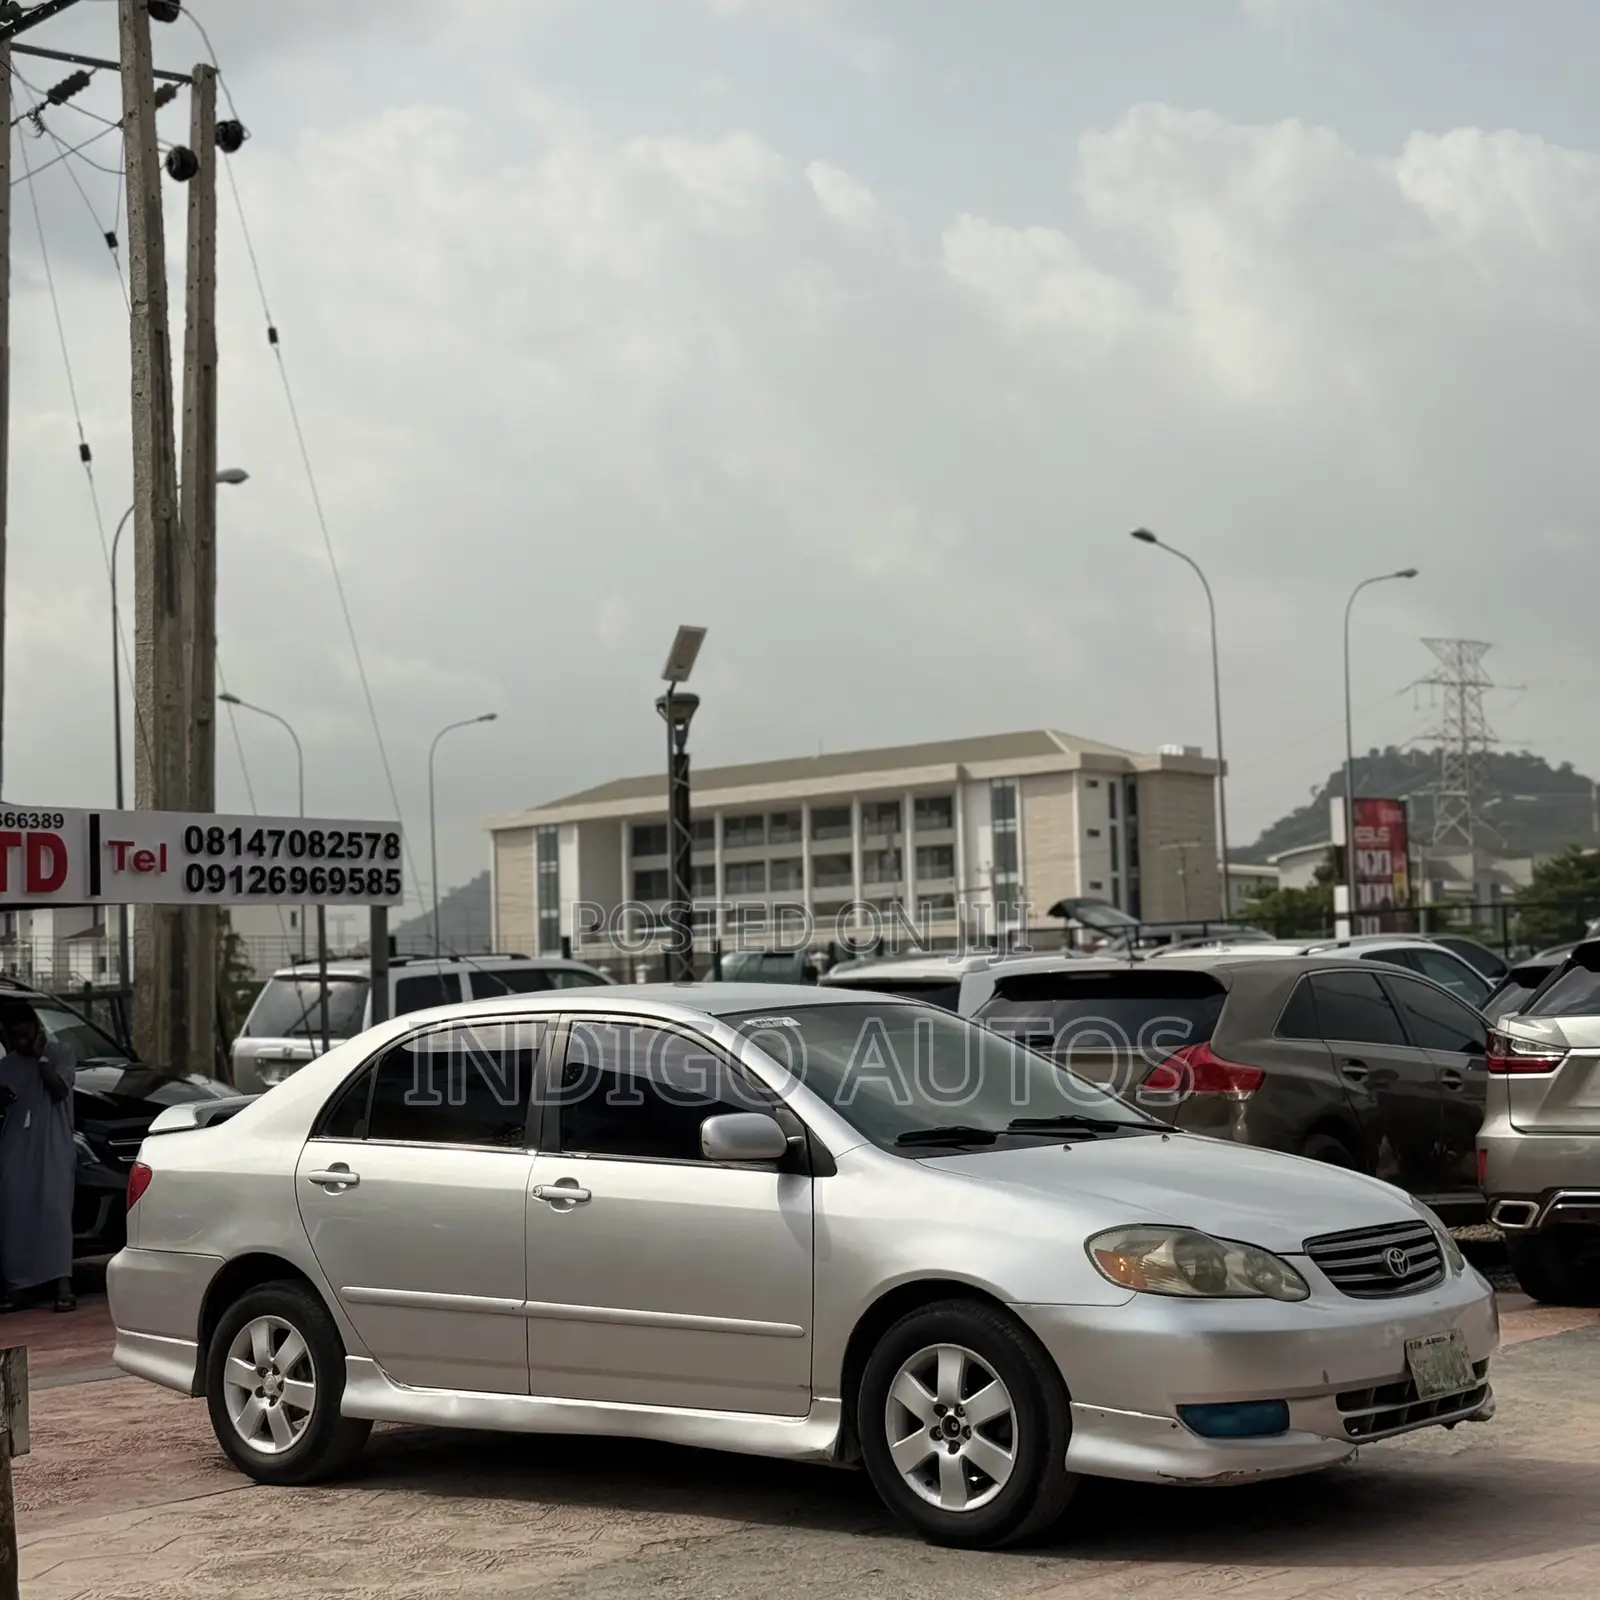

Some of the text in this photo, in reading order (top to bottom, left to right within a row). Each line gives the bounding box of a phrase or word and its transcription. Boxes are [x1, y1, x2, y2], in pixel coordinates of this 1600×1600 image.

[108, 840, 167, 873] Tel
[185, 826, 400, 859] 08147082578
[186, 864, 400, 895] 09126969585
